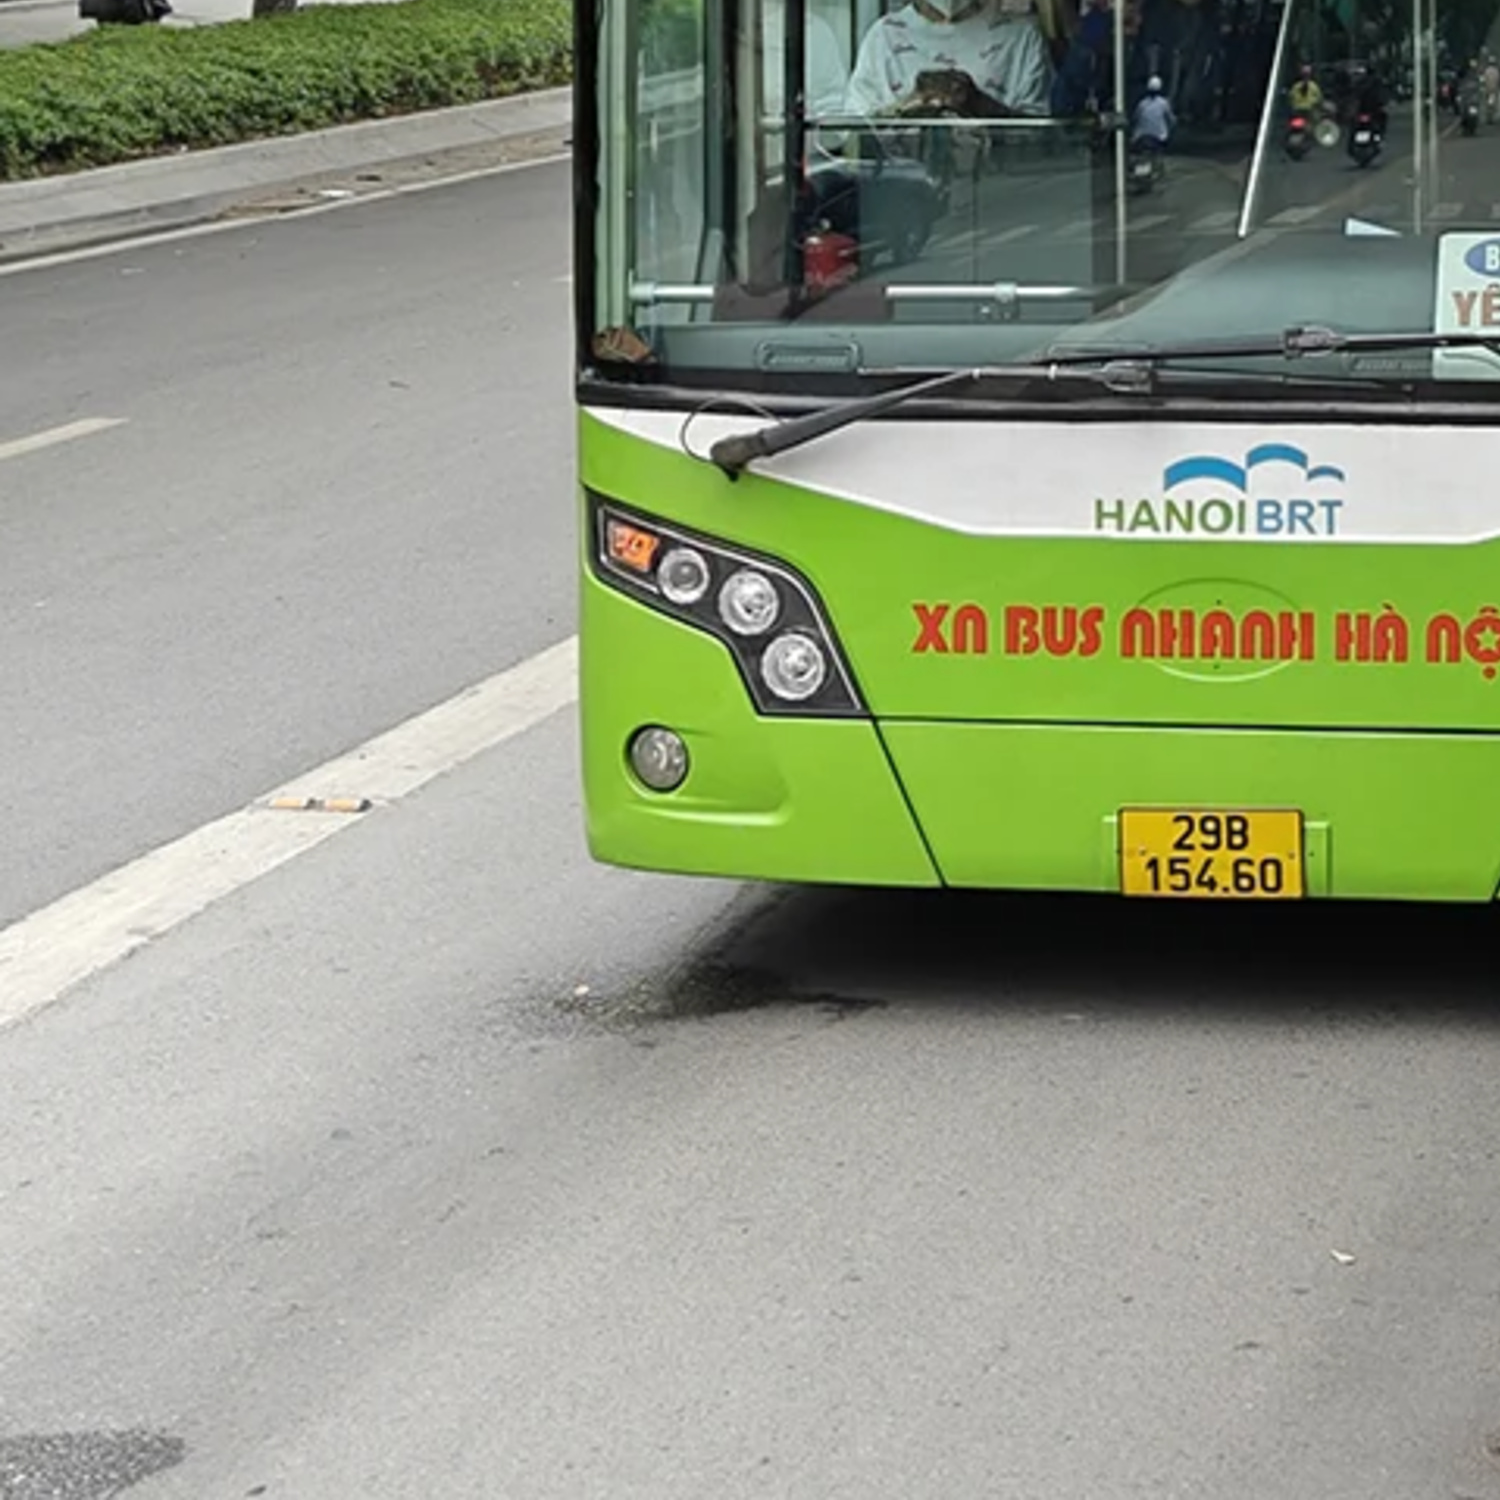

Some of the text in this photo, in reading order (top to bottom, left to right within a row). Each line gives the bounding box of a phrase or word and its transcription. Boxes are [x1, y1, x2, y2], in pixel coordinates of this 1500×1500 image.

[911, 604, 989, 655] XN
[1004, 607, 1104, 657] BUS
[1120, 609, 1316, 661] NHANH
[1335, 603, 1409, 663] HÀ
[1172, 814, 1249, 851] 29B
[1146, 857, 1283, 894] 154.60
